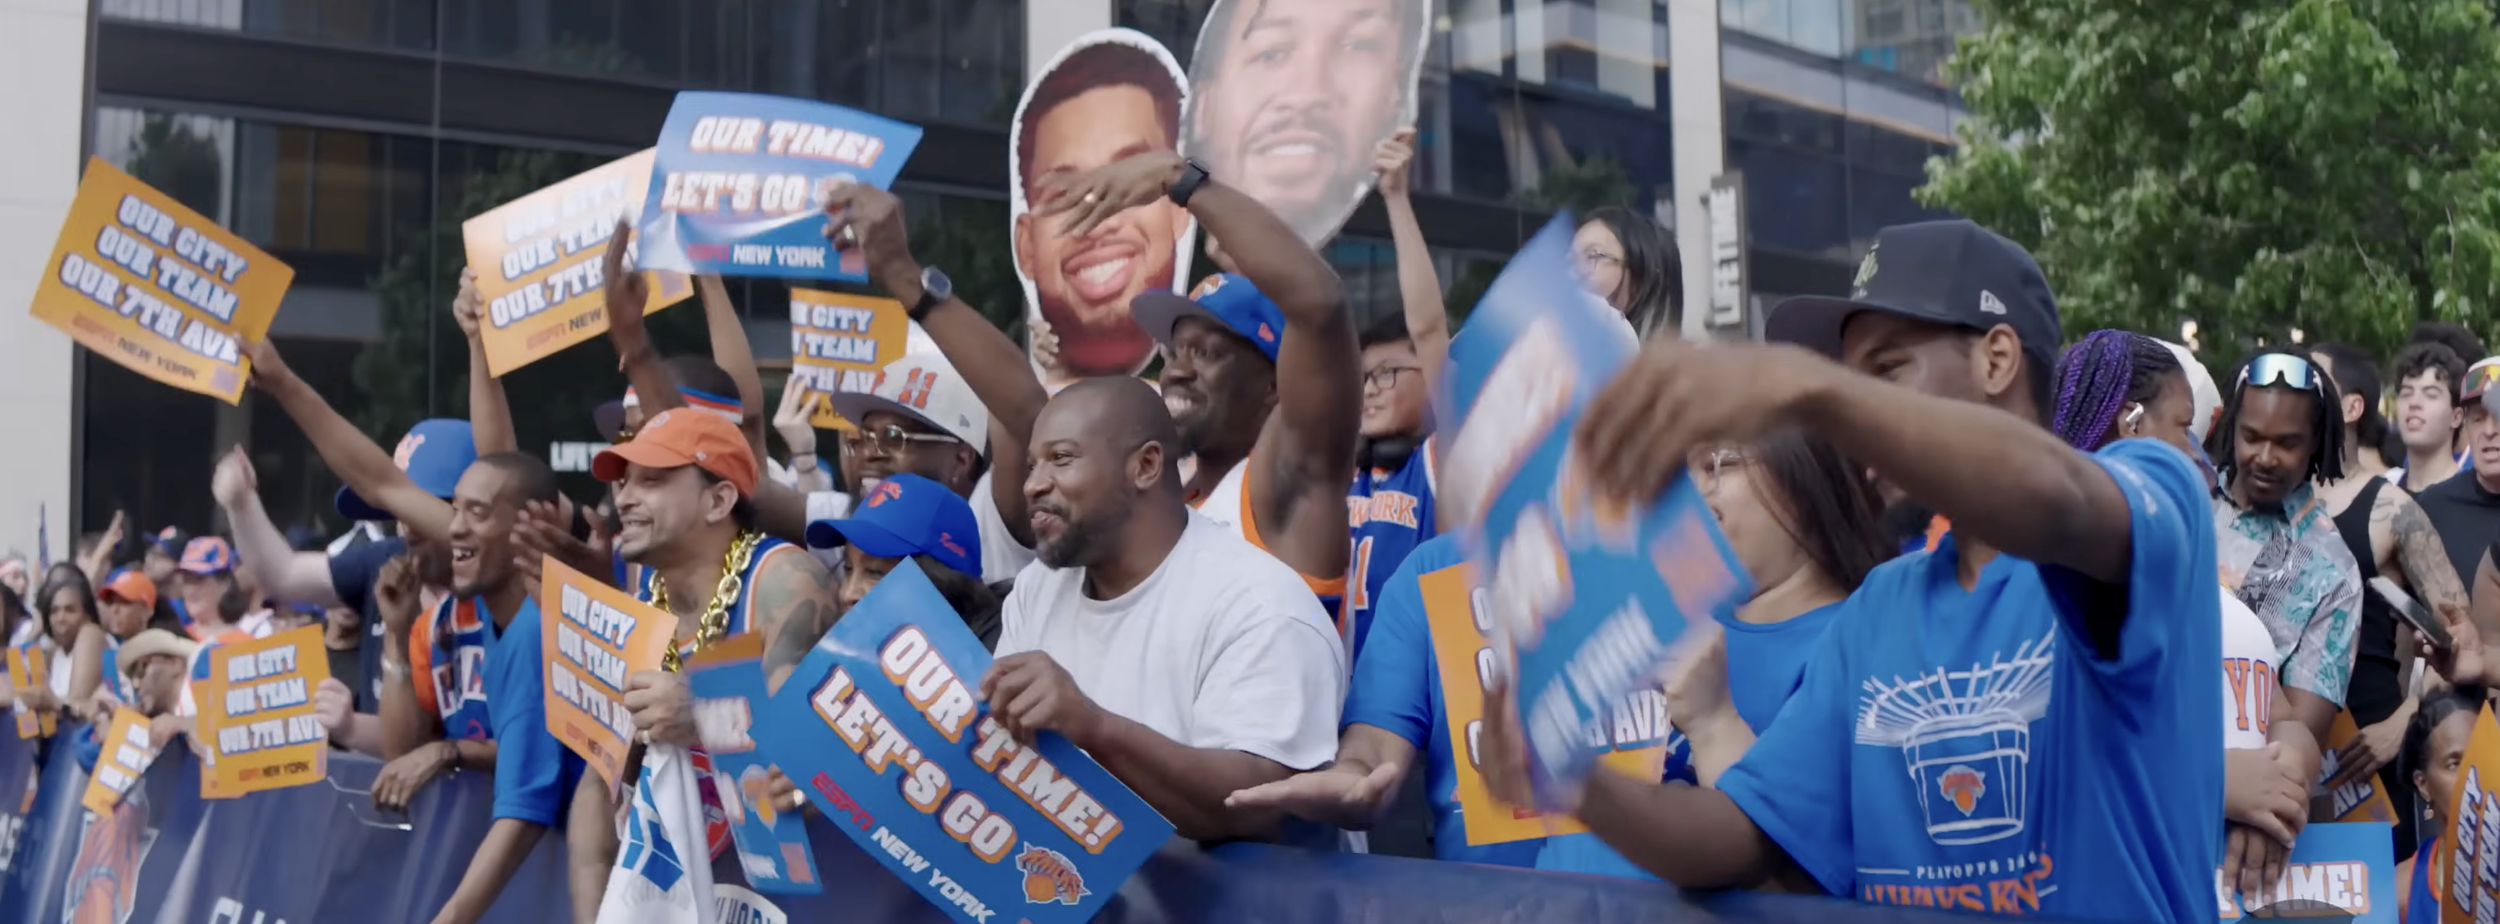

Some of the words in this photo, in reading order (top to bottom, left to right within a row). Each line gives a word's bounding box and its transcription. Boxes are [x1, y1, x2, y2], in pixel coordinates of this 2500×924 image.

[690, 116, 765, 155] OUR
[767, 120, 884, 168] TIME!
[661, 171, 759, 214] LET'S
[760, 173, 809, 217] GO
[117, 193, 177, 249] OUR
[174, 225, 249, 286] CITY
[501, 237, 559, 281] OUR
[733, 244, 773, 266] NEW
[776, 246, 826, 268] YORK
[59, 251, 121, 310] OUR
[119, 283, 184, 341] 7TH
[95, 223, 155, 281] OUR
[156, 254, 239, 324] TEAM
[489, 282, 547, 329] OUR
[547, 254, 604, 305] 7TH
[569, 309, 603, 331] NEW
[804, 332, 878, 364] TEAM
[811, 304, 874, 335] CITY
[839, 368, 877, 395] AV
[561, 582, 590, 630] OUR
[587, 599, 637, 650] CITY
[257, 644, 297, 677] CITY
[557, 620, 585, 668] OUR
[582, 637, 627, 693] TEAM
[257, 677, 309, 711] TEAM
[551, 660, 580, 707] OUR
[578, 678, 612, 732] 7TH
[611, 700, 634, 744] AV
[2223, 657, 2277, 733] YO
[807, 664, 952, 814] LET'S
[939, 789, 1018, 864] GO
[876, 623, 979, 745] OUR
[970, 712, 1125, 855] TIME!
[2457, 765, 2484, 860] CITY
[810, 770, 876, 832] ESPN
[871, 826, 931, 874] NEW
[927, 869, 997, 924] YORK
[1916, 859, 2000, 881] PLAYOFFS
[2452, 847, 2475, 914] OUR
[2250, 861, 2370, 917] IME!
